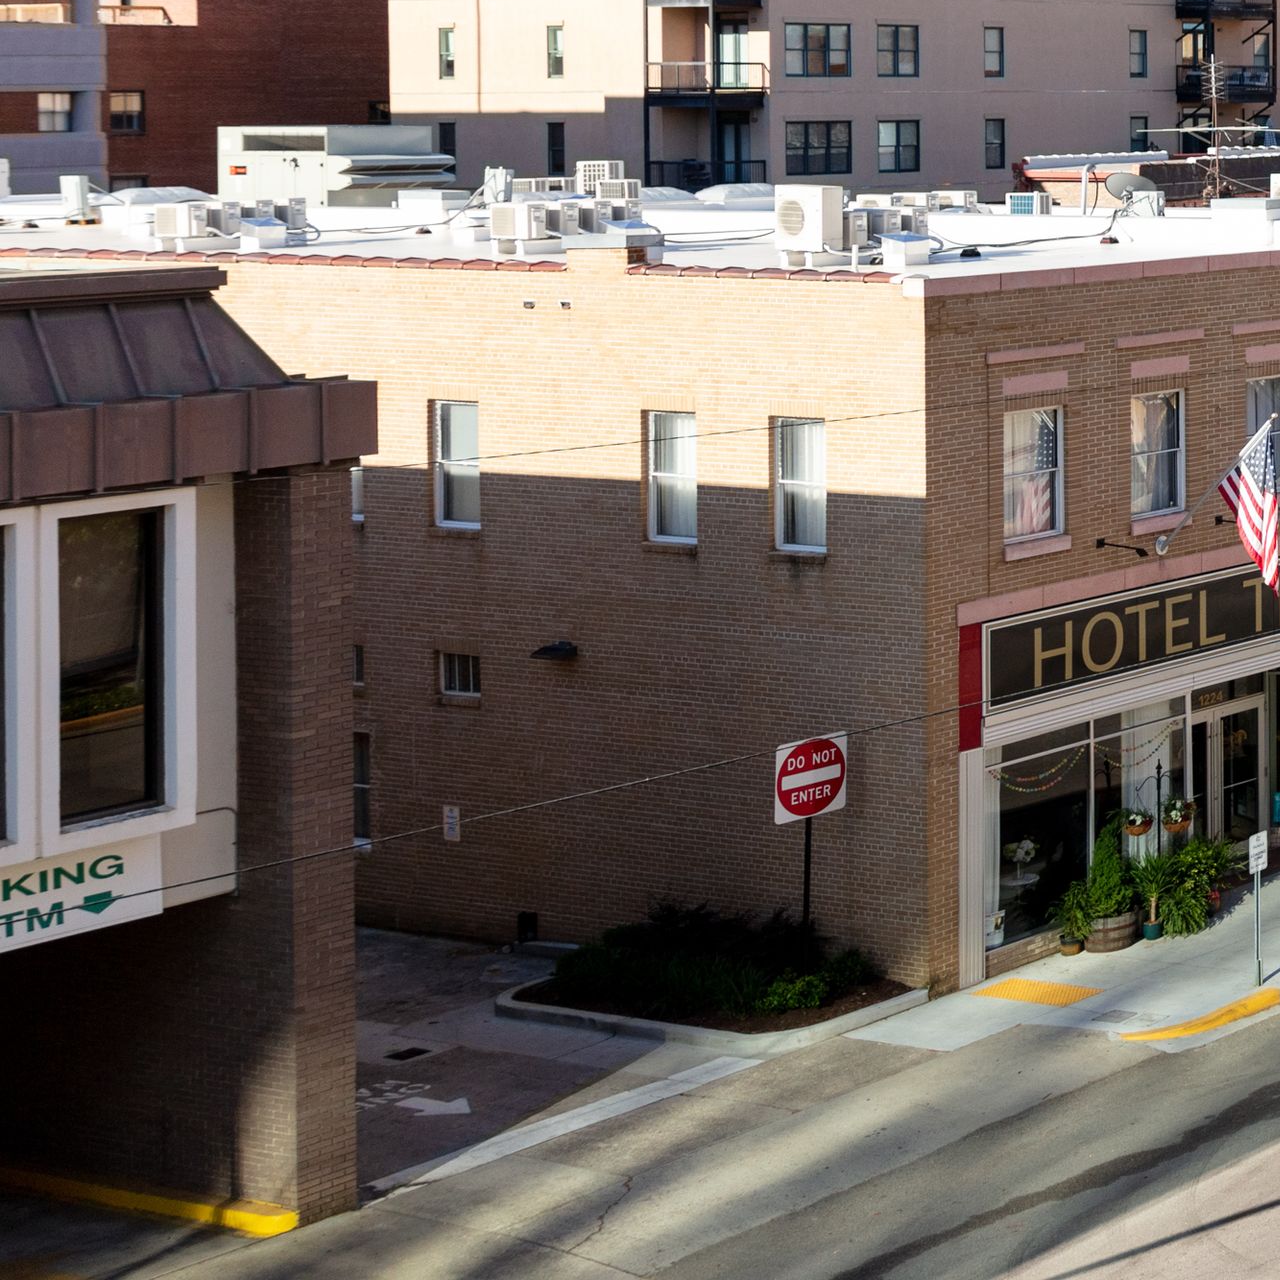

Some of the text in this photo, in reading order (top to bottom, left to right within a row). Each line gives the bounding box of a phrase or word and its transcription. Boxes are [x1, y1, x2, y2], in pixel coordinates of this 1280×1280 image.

[1033, 589, 1226, 689] HOTEL
[1199, 691, 1224, 706] 1224
[787, 748, 837, 771] DO NOT
[791, 784, 831, 806] ENTER
